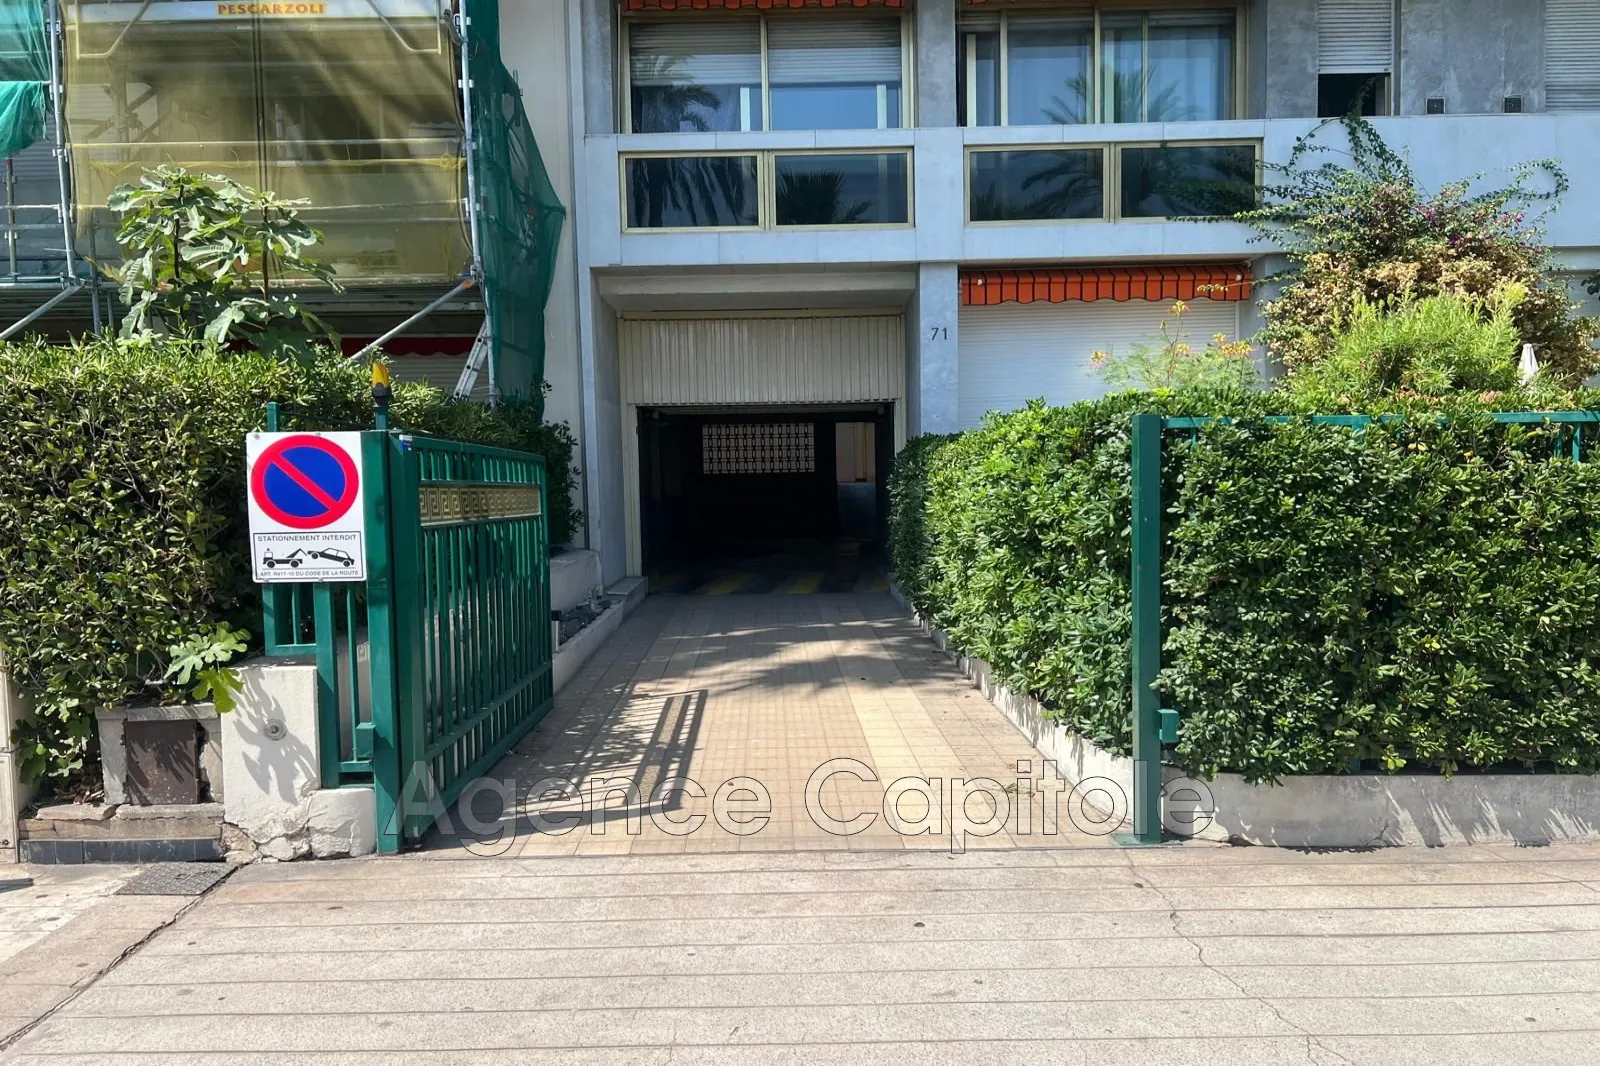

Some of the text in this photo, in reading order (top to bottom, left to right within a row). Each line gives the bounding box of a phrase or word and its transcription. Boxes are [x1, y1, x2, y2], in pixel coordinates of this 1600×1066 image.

[217, 3, 325, 15] PESCARZOLI
[931, 327, 948, 340] 71
[257, 534, 320, 542] STATIONNEMENT
